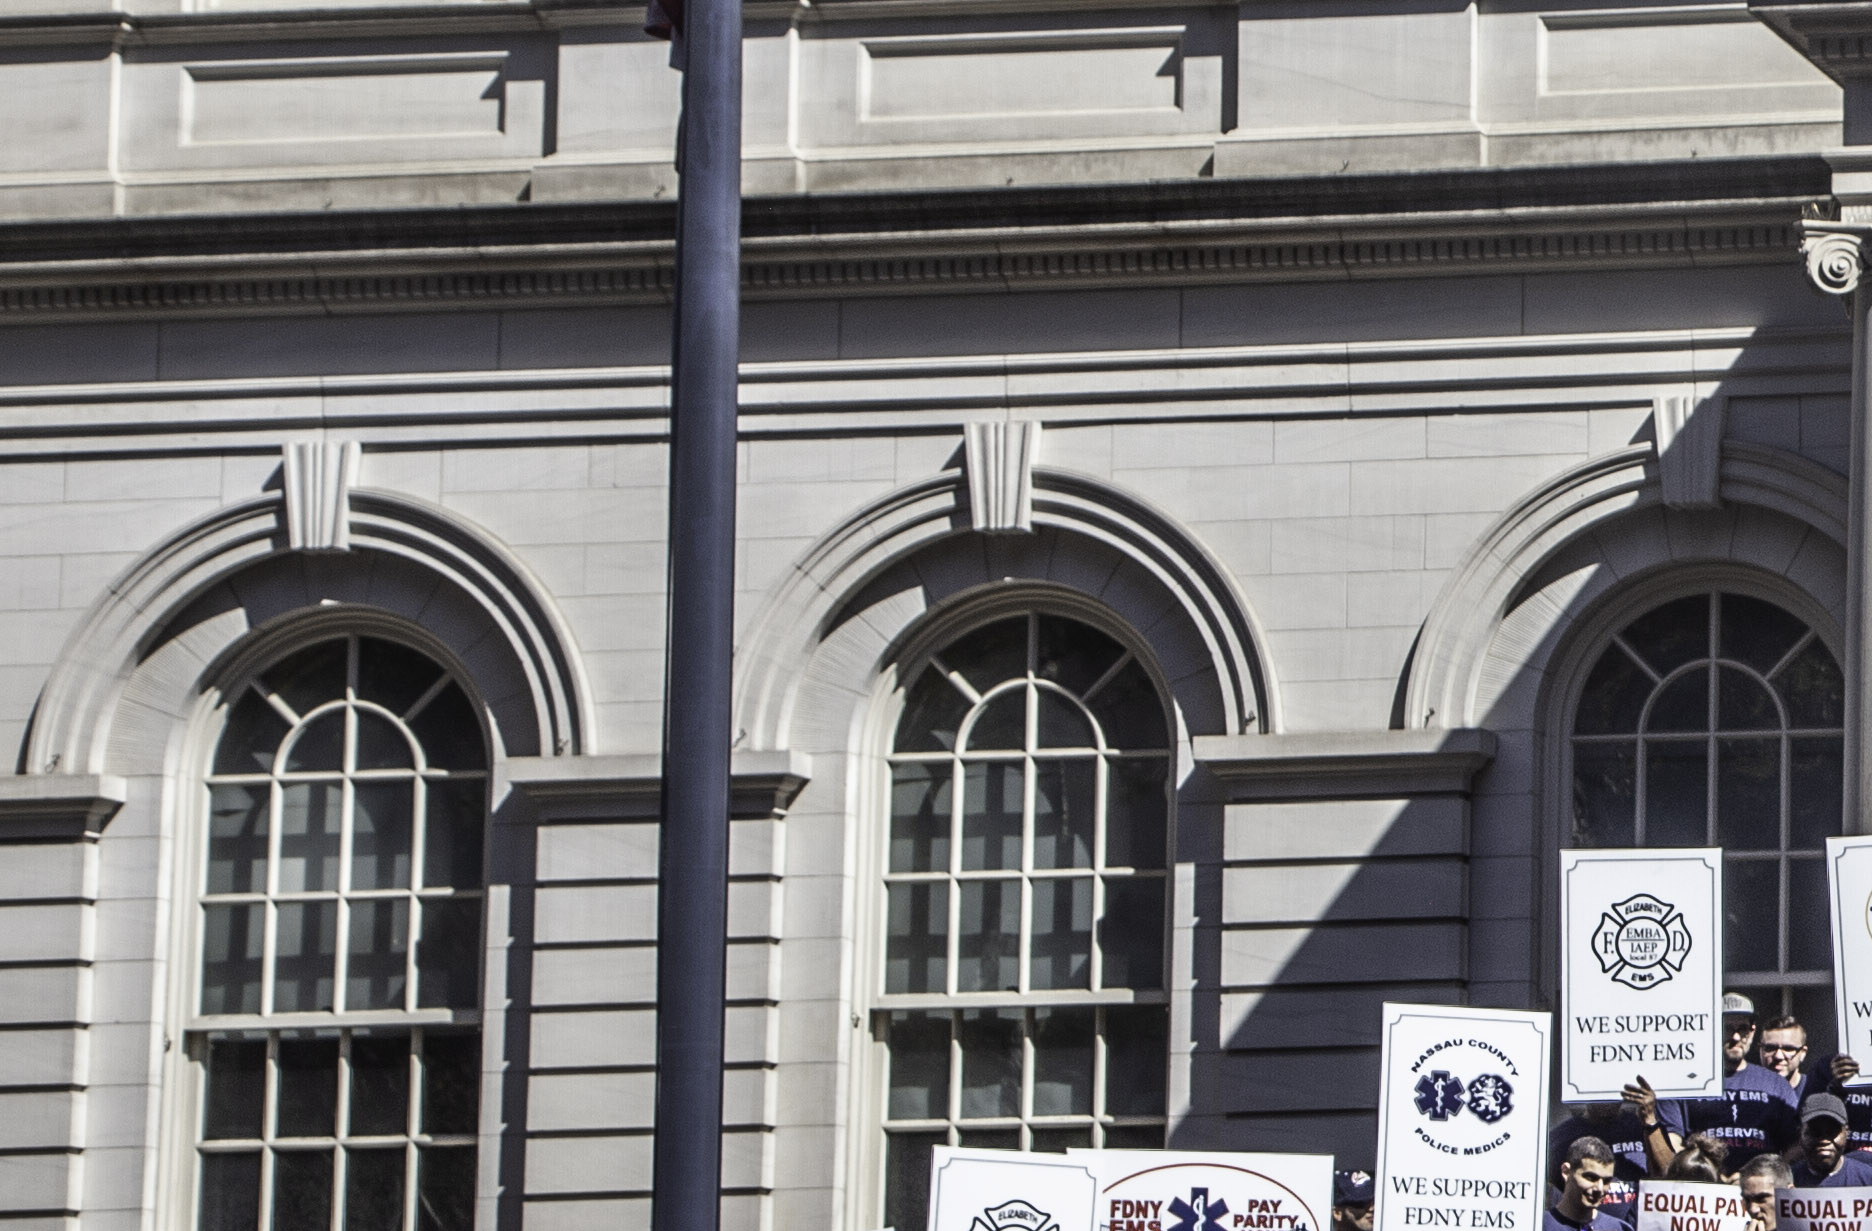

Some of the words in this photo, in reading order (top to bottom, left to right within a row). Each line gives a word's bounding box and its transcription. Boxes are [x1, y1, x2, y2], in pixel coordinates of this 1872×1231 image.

[1576, 1016, 1610, 1033] WE
[1615, 1013, 1708, 1033] SUPPORT
[1411, 1038, 1464, 1073] NASSAU
[1468, 1039, 1519, 1077] COUNTY
[1590, 1044, 1647, 1063] FDNY
[1653, 1043, 1695, 1061] EMS
[1414, 1128, 1458, 1155] POLICE
[1464, 1132, 1511, 1155] MEDICS
[1392, 1176, 1427, 1194] WE
[1432, 1178, 1530, 1200] SUPPORT
[998, 1209, 1038, 1224] ELIZABETH
[1110, 1200, 1162, 1219] FDNY
[1248, 1200, 1282, 1213] PAY
[1780, 1199, 1847, 1219] EQUAL
[1234, 1214, 1298, 1229] PARITY
[1405, 1207, 1465, 1226] FDNY
[1471, 1210, 1515, 1229] EMS
